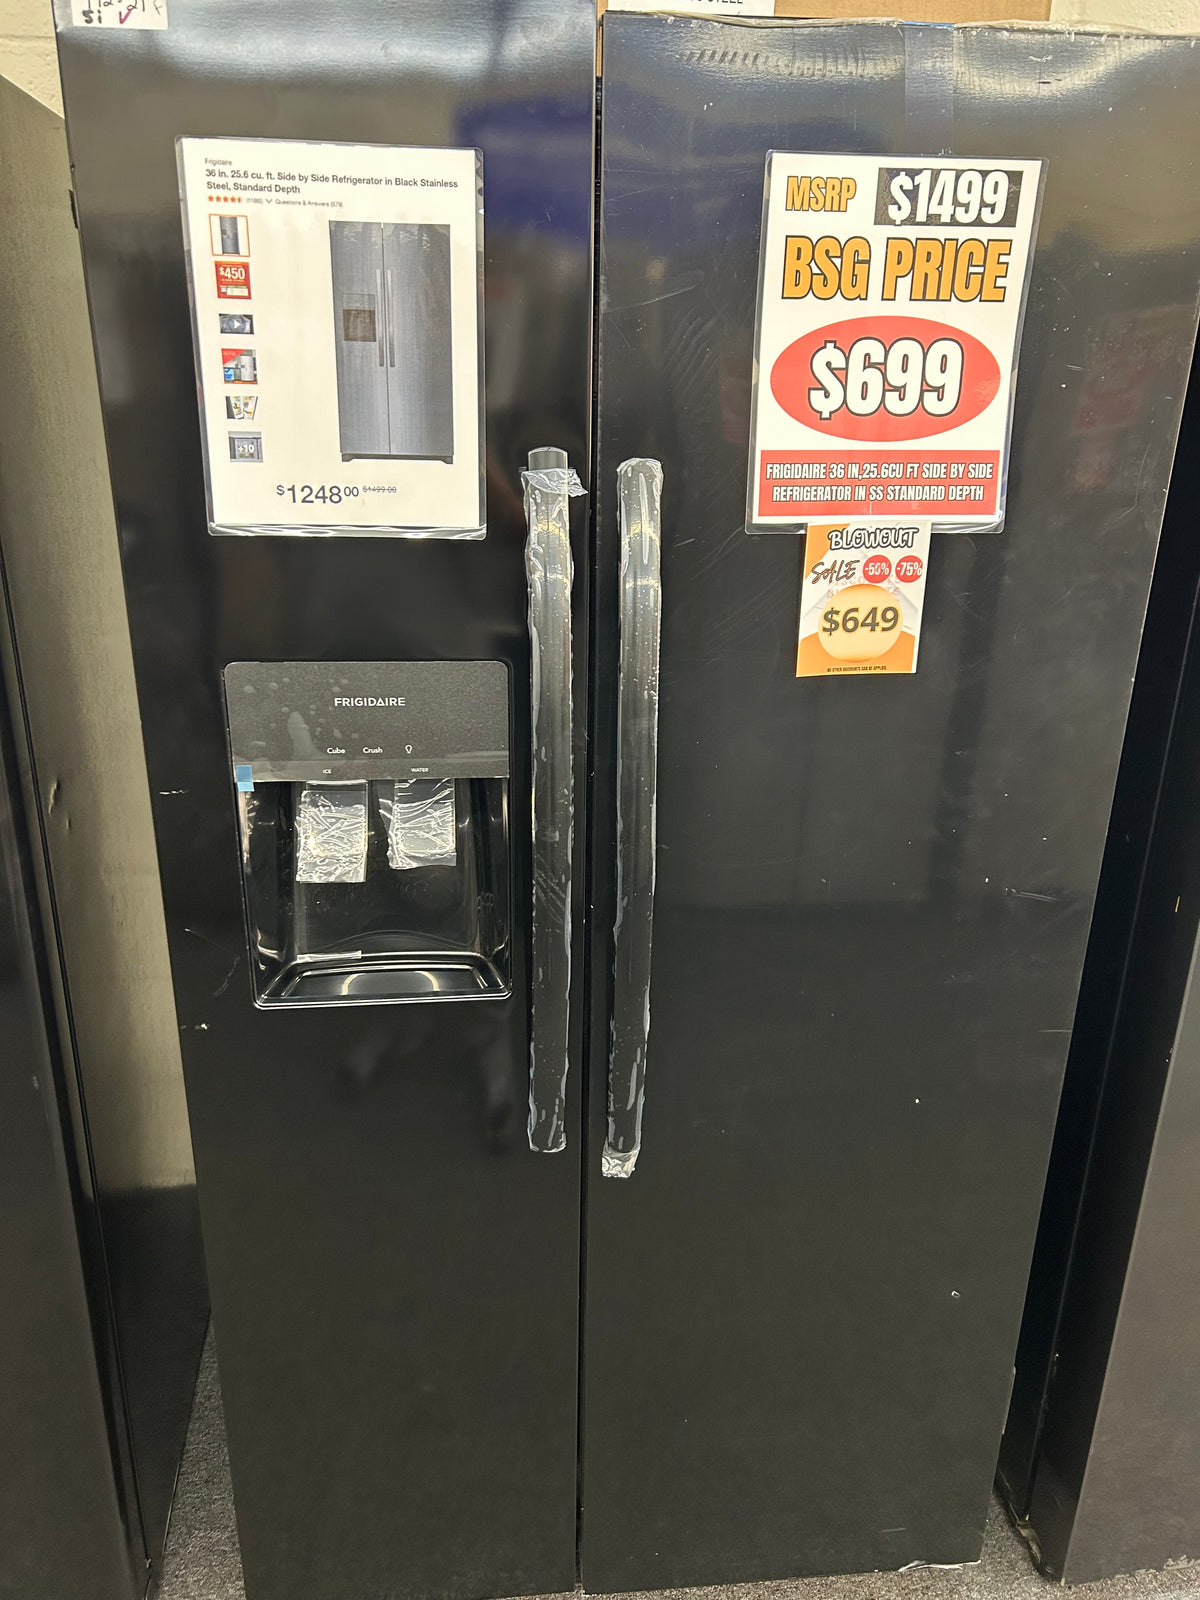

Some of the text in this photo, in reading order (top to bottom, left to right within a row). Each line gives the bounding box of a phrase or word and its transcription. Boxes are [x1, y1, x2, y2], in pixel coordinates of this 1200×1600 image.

[205, 168, 216, 177] 36
[230, 170, 249, 179] 25.6
[250, 172, 264, 180] cu.
[266, 172, 275, 180] ft.
[277, 172, 296, 181] Side
[298, 173, 309, 183] by
[310, 173, 330, 183] Side
[331, 174, 383, 186] Refrigerator
[384, 176, 393, 186] in
[394, 177, 418, 187] Black
[420, 178, 458, 188] Stainless
[206, 181, 300, 195] Steel, Standard Depth
[785, 175, 857, 213] MSRP
[886, 169, 1010, 226] $1499
[219, 266, 246, 280] $450
[781, 235, 1013, 303] BSG PRICE
[808, 336, 964, 421] $699
[765, 462, 828, 480] FRIGIDAIRE
[829, 462, 845, 480] 36
[905, 462, 920, 479] FT
[921, 462, 948, 479] SIDE
[949, 462, 966, 479] BY
[967, 462, 994, 479] SIDE
[772, 485, 984, 502] REFRIGERATOR IN SS STANDARD DEPTH
[827, 527, 920, 551] BLOWOUT
[811, 559, 861, 584] SALE
[822, 606, 900, 637] $649
[334, 697, 406, 707] FRIGIDAIRE
